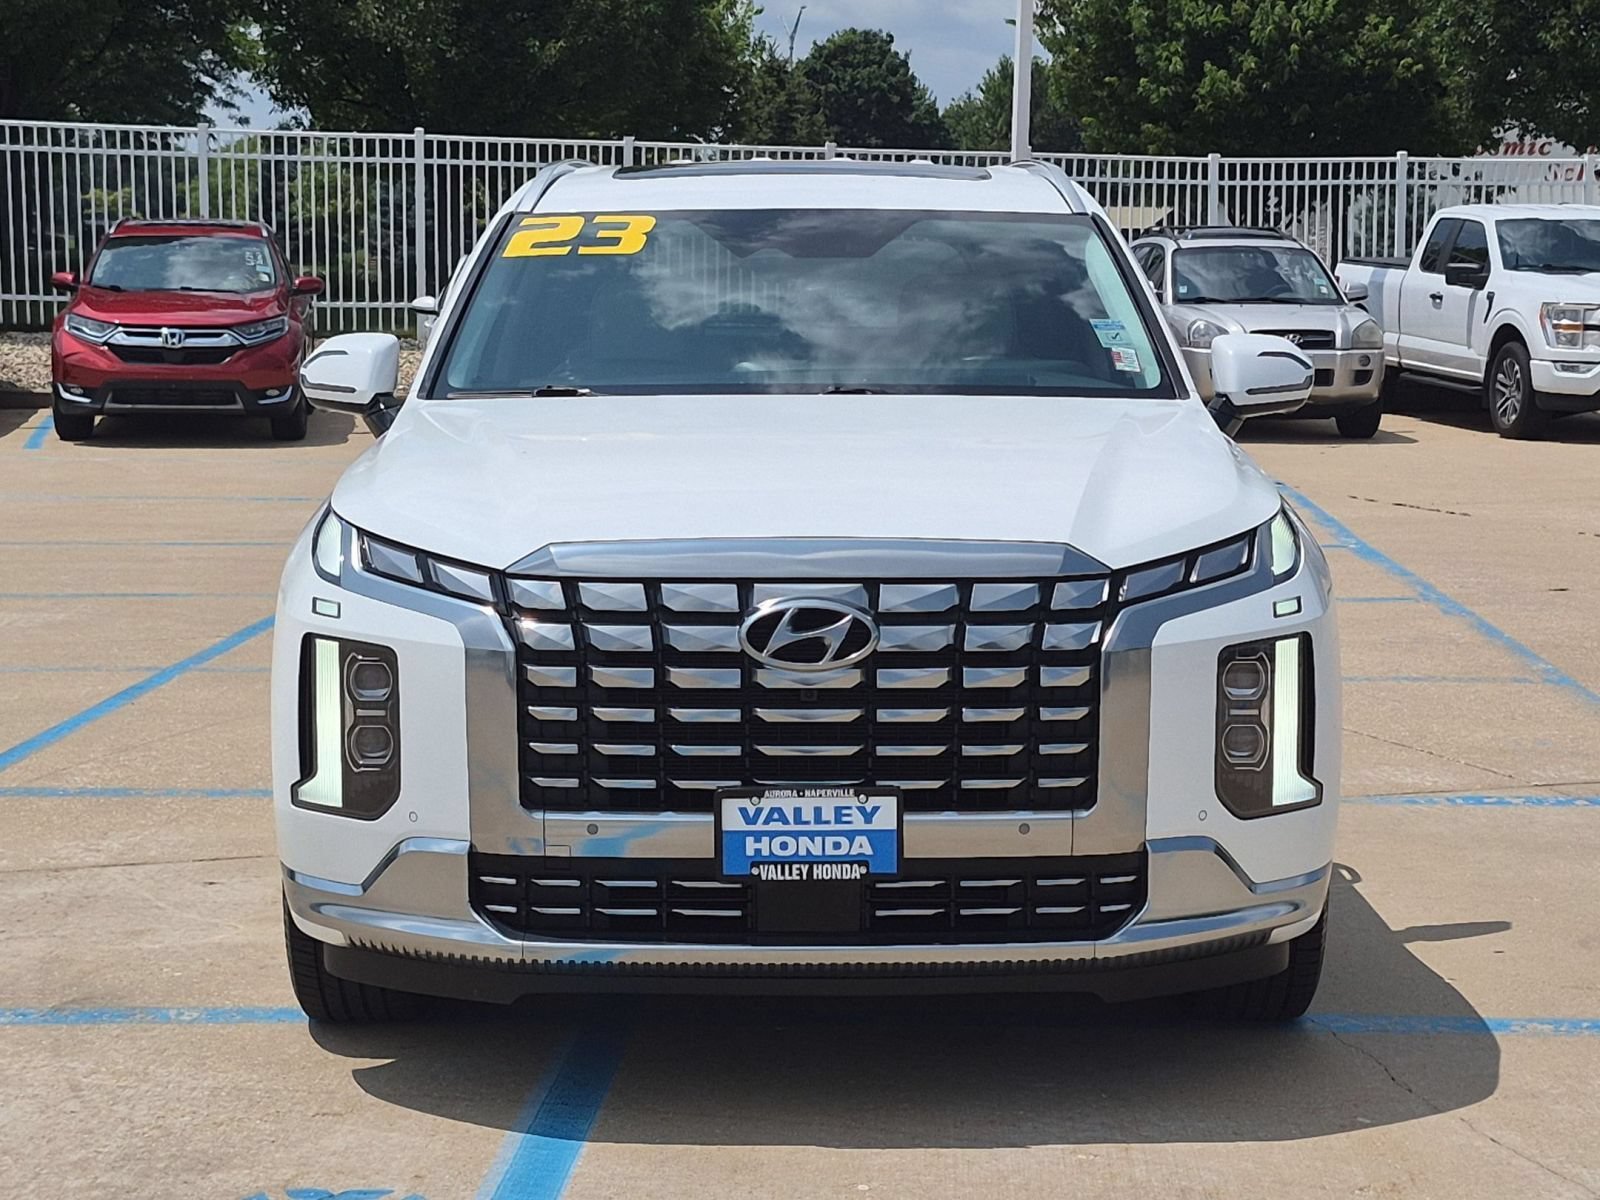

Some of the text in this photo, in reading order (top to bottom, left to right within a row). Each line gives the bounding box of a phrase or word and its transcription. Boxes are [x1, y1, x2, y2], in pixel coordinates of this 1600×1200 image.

[502, 215, 657, 258] 23
[763, 788, 856, 799] AURORA NAPERVILLE
[738, 805, 882, 826] VALLEY
[745, 835, 874, 857] HONDA
[759, 862, 861, 881] VALLEY HONDA
